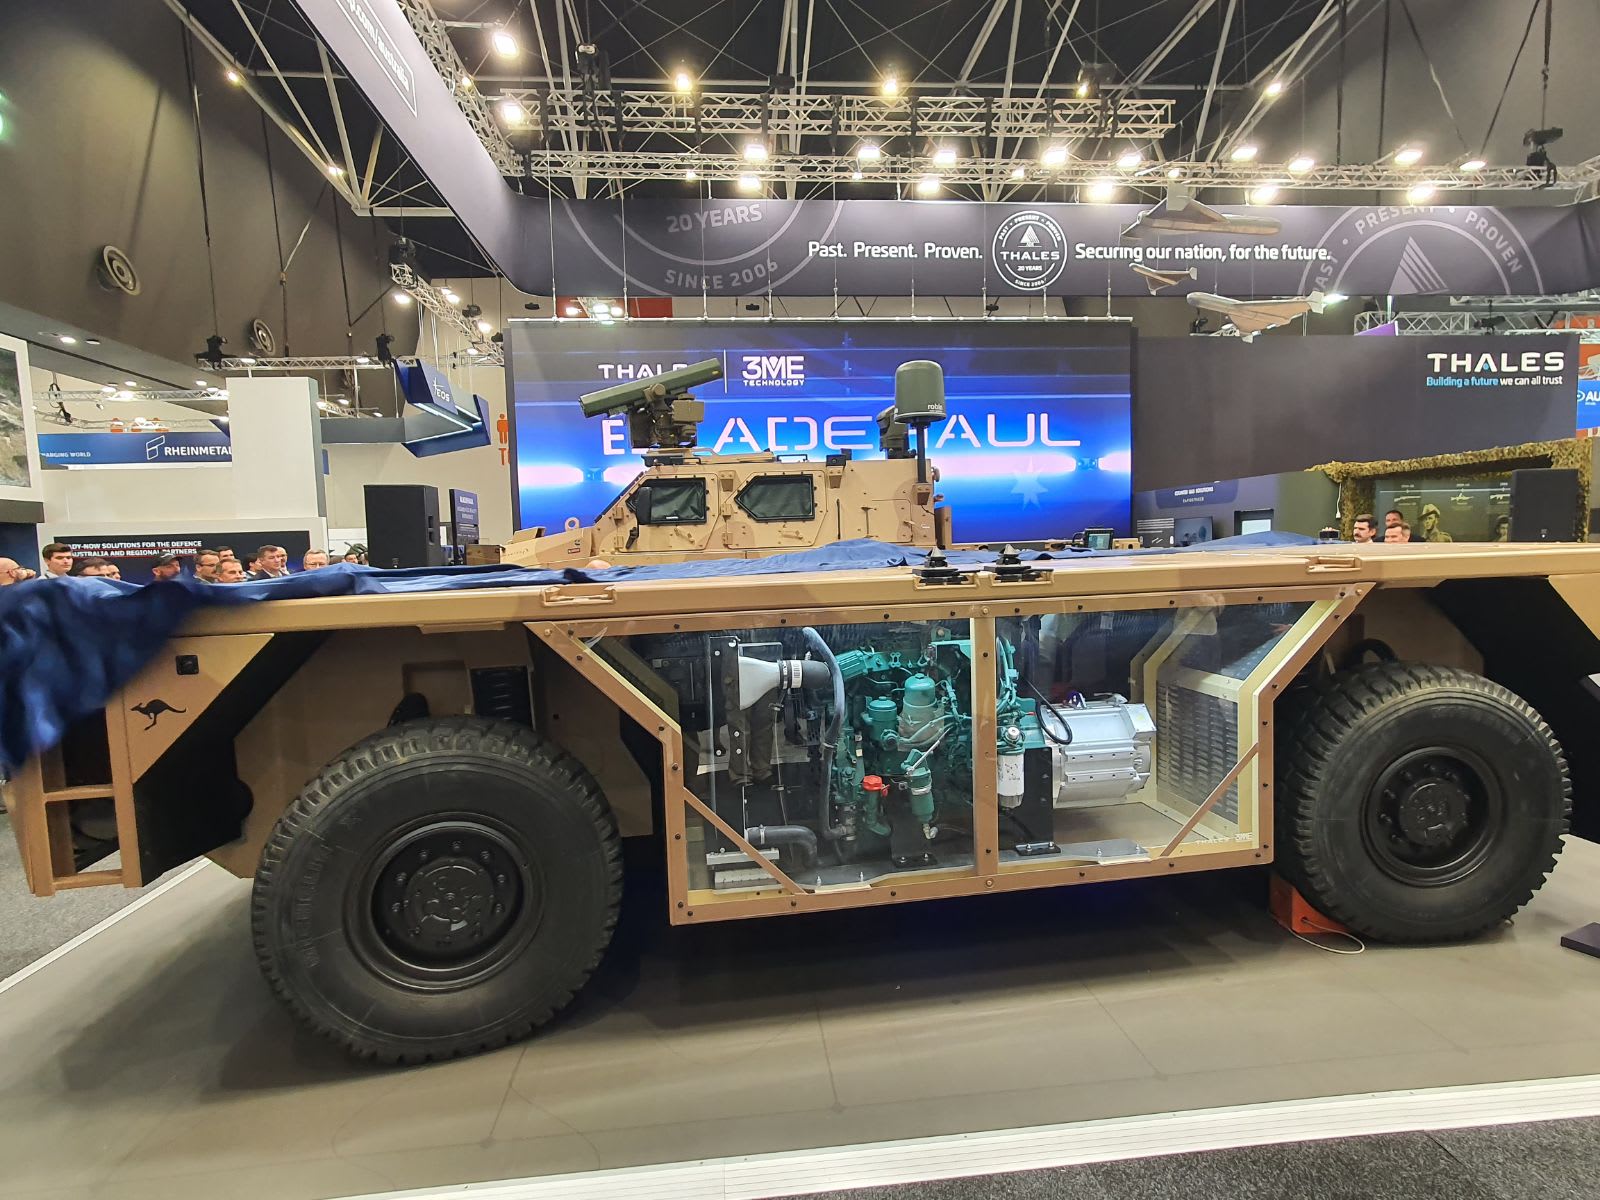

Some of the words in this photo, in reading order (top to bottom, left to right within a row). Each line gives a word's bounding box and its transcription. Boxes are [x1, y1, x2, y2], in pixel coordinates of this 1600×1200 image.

[666, 213, 693, 233] 20
[694, 203, 763, 229] YEARS
[808, 241, 848, 258] Past.
[853, 241, 918, 259] Present.
[924, 242, 983, 260] Proven.
[1465, 210, 1523, 273] PROVEN
[1000, 251, 1060, 261] THALES
[1075, 243, 1142, 263] Securing
[1146, 247, 1171, 260] our
[1175, 244, 1227, 262] nation,
[1229, 244, 1252, 260] for
[1254, 244, 1279, 260] the
[1281, 245, 1331, 261] future.
[664, 269, 724, 290] SINCE
[729, 259, 779, 288] 2006
[1313, 252, 1338, 292] AST
[598, 363, 688, 379] THAL
[742, 355, 805, 379] 3ME
[1427, 351, 1565, 373] THALES
[742, 379, 805, 387] TECHNOLOGY
[1426, 376, 1463, 389] Building
[1471, 376, 1499, 387] future
[1500, 377, 1513, 386] we
[1514, 378, 1530, 386] can
[1531, 375, 1541, 384] all
[1542, 375, 1563, 385] trust
[436, 388, 450, 403] EOS
